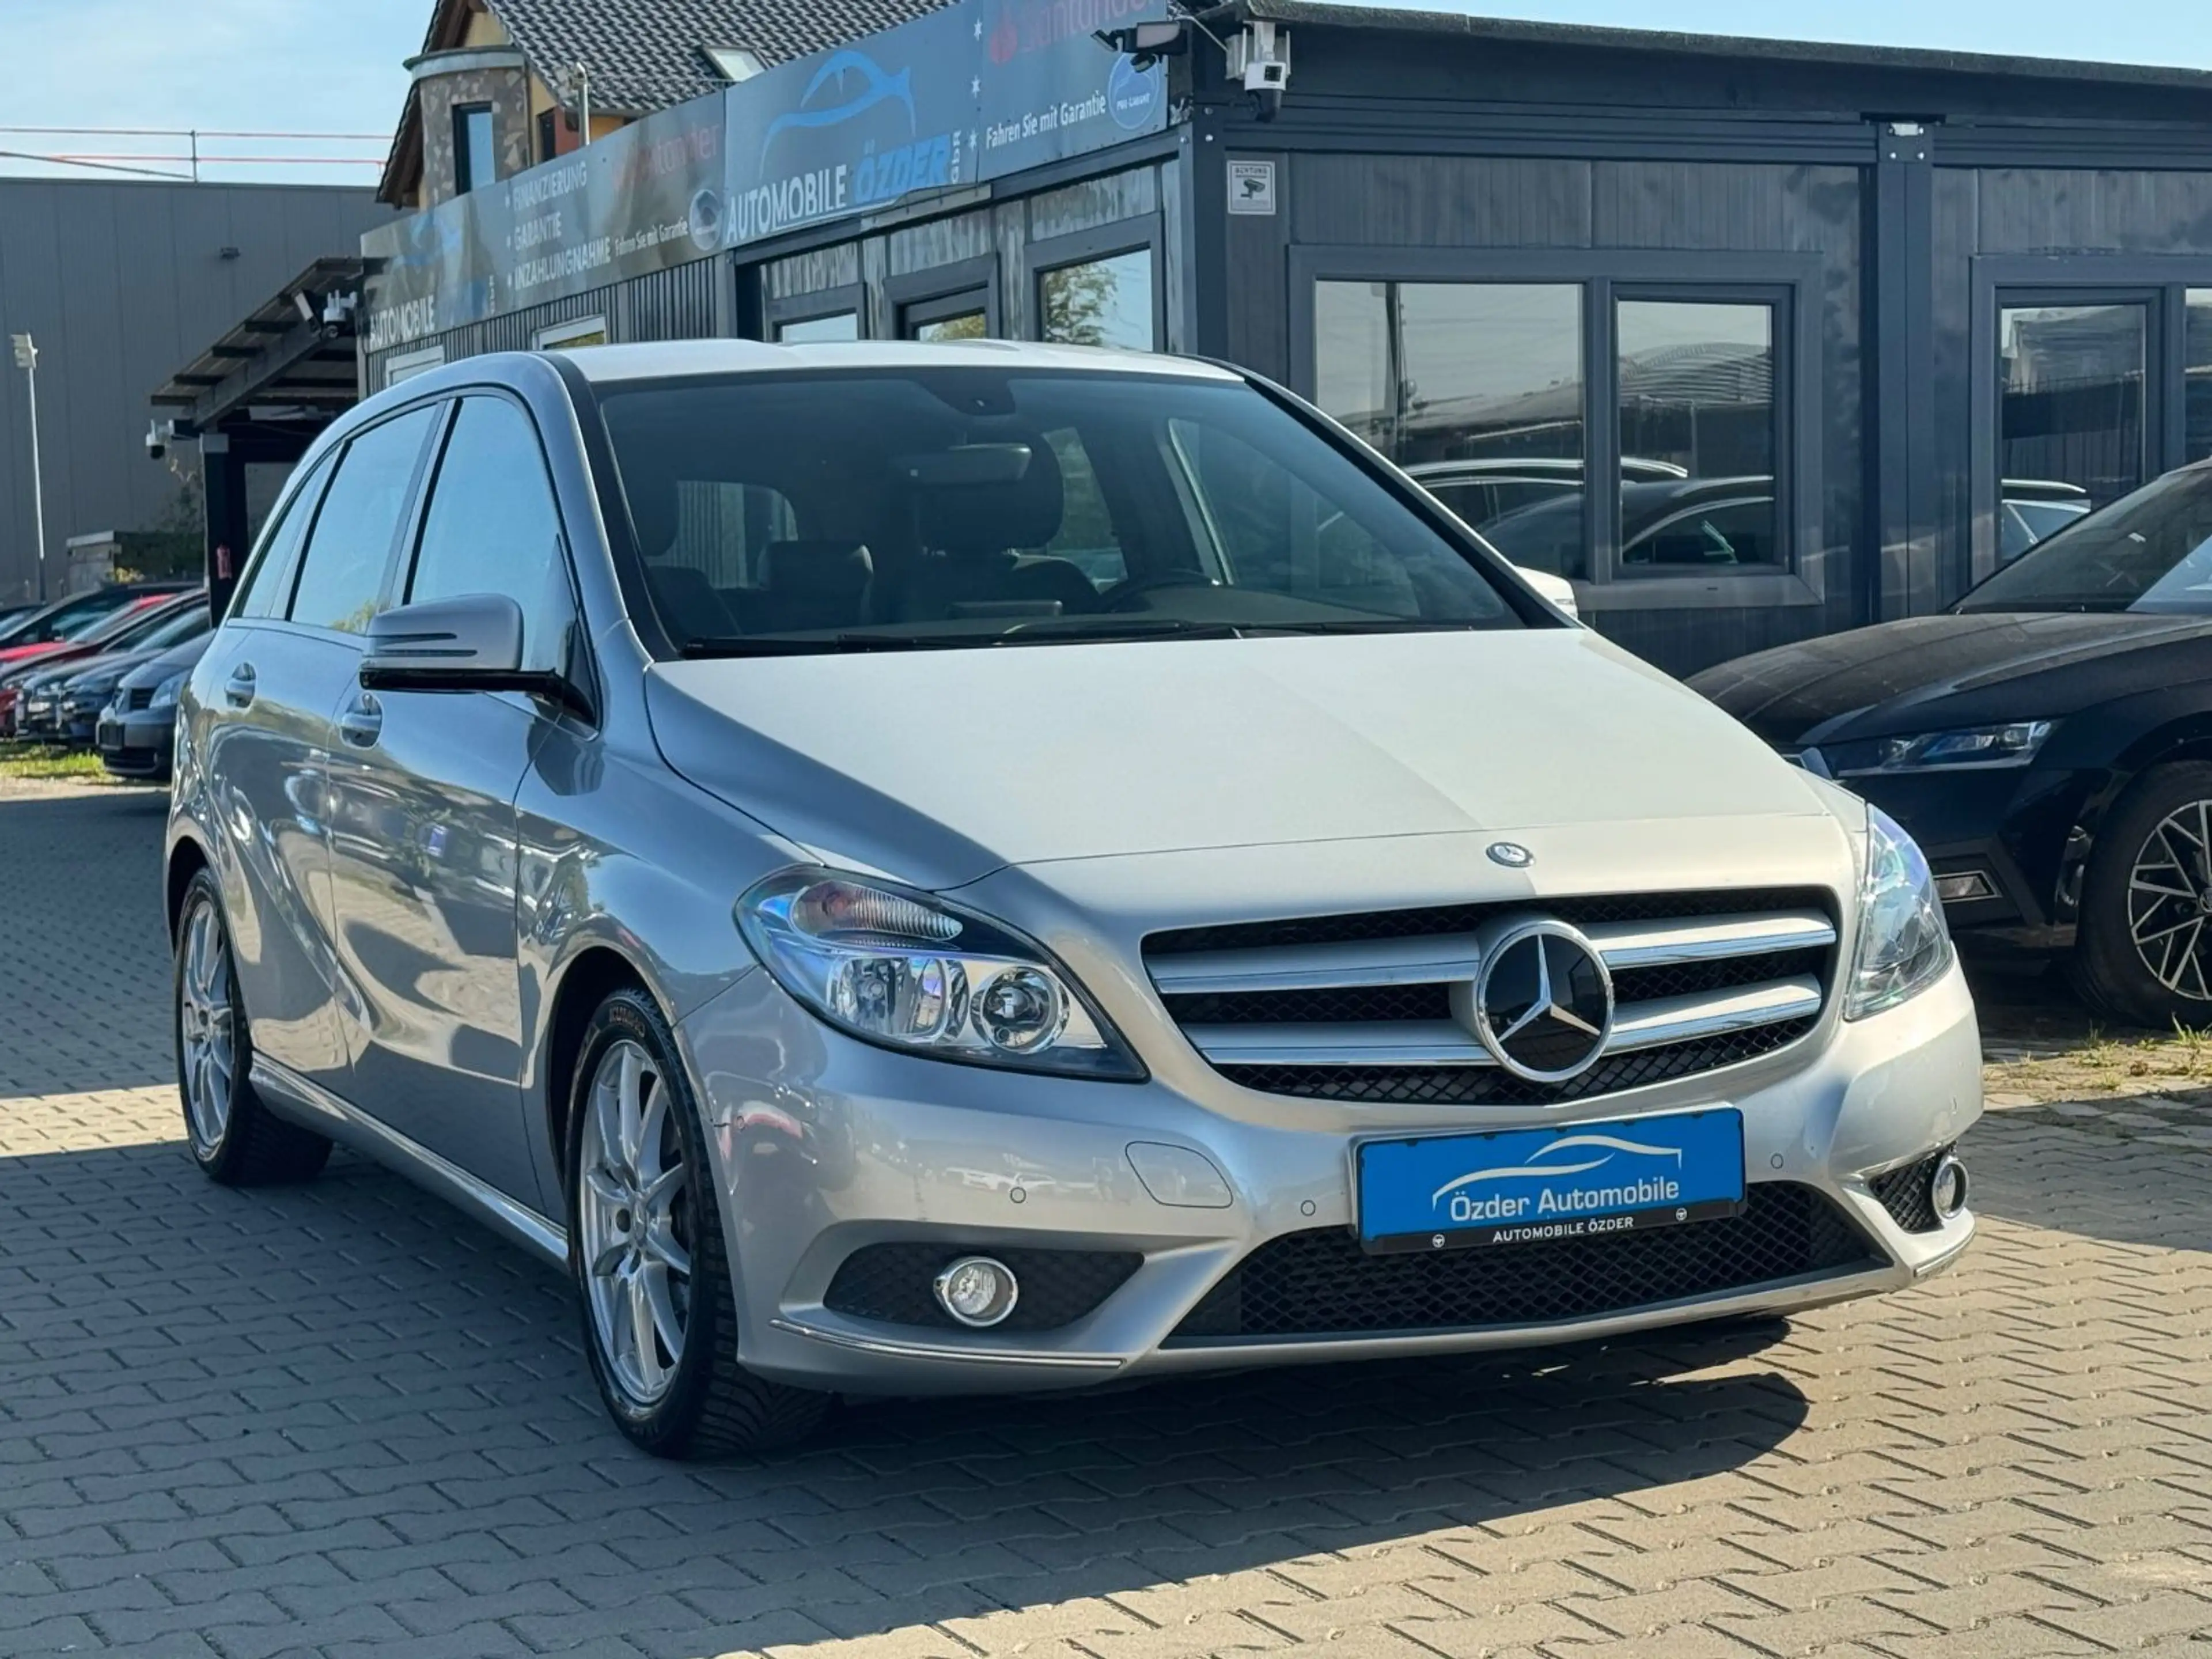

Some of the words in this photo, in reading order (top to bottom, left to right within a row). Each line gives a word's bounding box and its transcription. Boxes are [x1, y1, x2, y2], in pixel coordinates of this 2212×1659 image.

[986, 123, 1020, 149] Fahren
[1022, 112, 1037, 138] Sie
[1039, 107, 1058, 132] mit
[1060, 90, 1106, 126] Garantie
[513, 161, 587, 211] FINANZIERUNG
[726, 164, 847, 244] AUTOMOBILE
[852, 134, 949, 204] ÖZDER
[514, 211, 562, 251] GARANTIE
[369, 294, 435, 352] AUTOMOBILE
[1450, 1190, 1530, 1222] Özder
[1537, 1176, 1680, 1214] Automobile
[1493, 1221, 1584, 1243] AUTOMOBILE
[1588, 1216, 1634, 1234] ÖZDER
